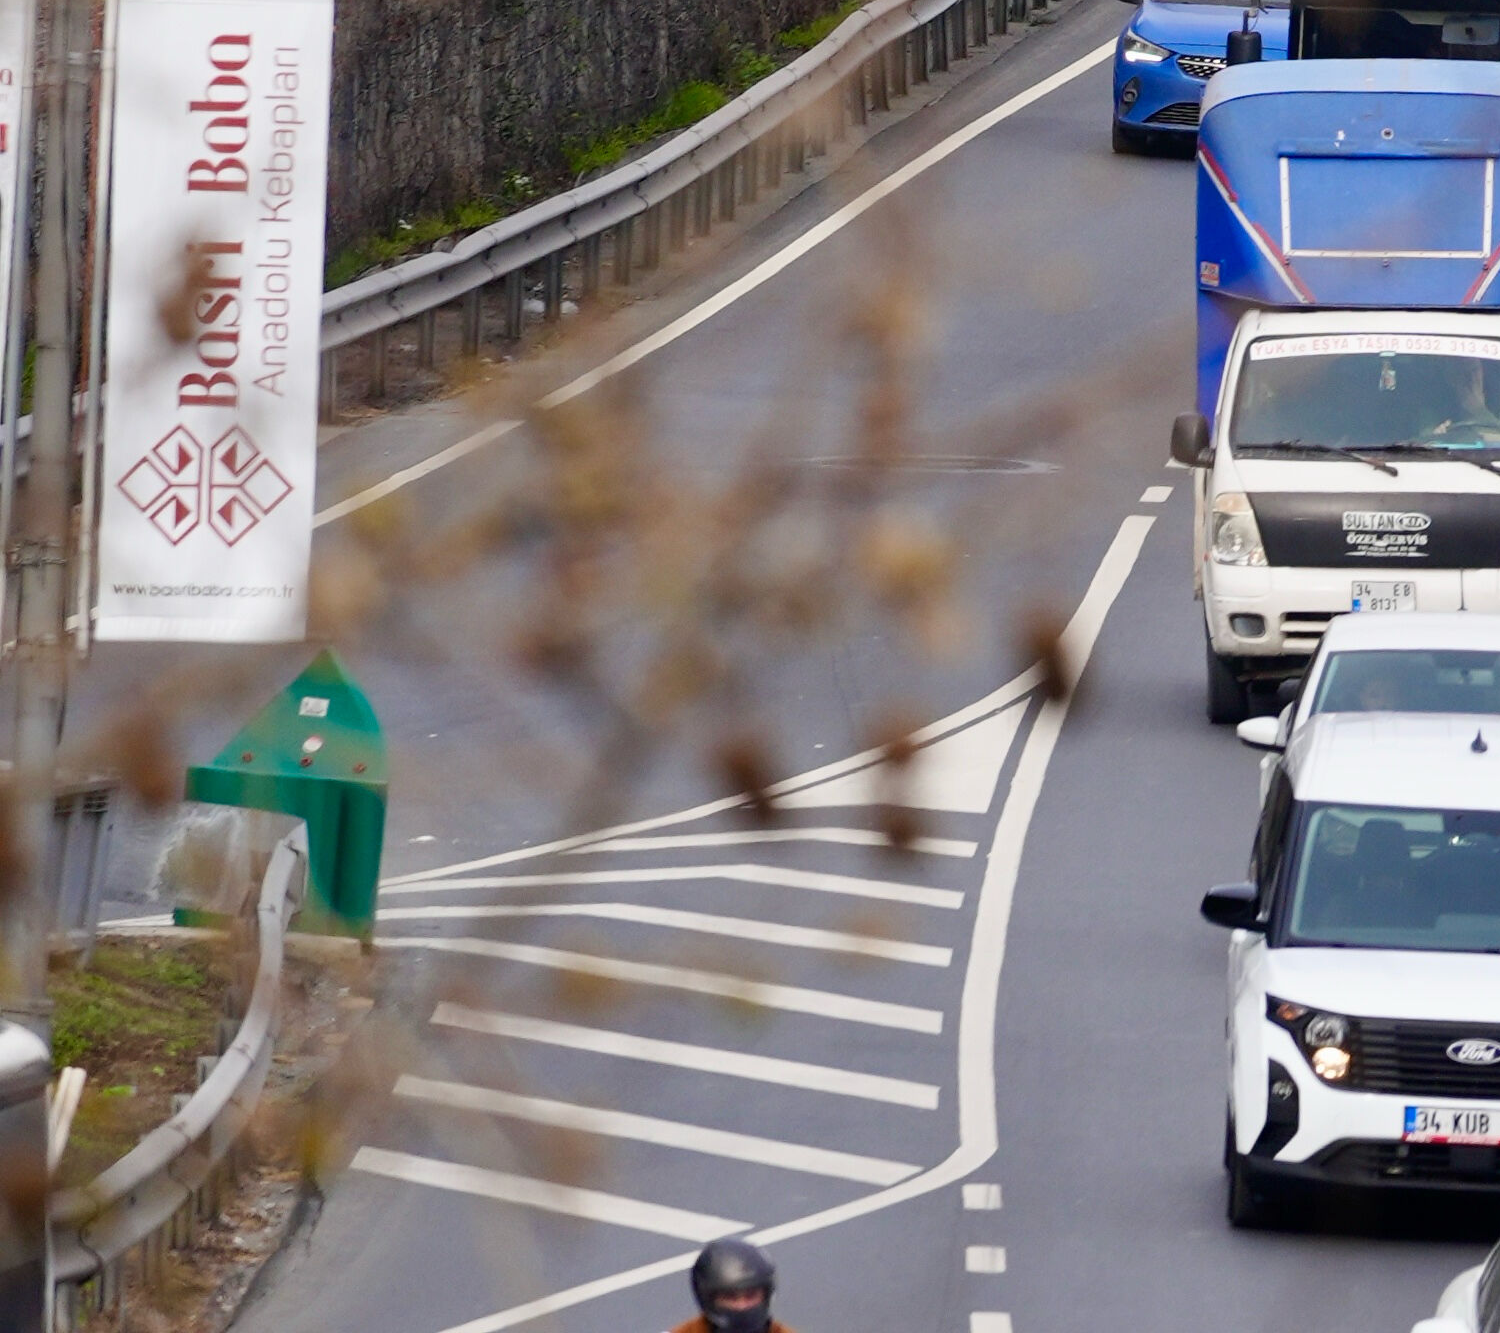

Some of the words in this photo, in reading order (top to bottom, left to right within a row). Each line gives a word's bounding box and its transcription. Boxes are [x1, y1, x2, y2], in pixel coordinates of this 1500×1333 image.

[187, 32, 252, 194] Baba
[258, 46, 306, 224] Kebapları
[178, 241, 244, 409] Basri
[253, 238, 292, 398] Anadolu
[1405, 340, 1441, 351] 0532
[1482, 343, 1499, 356] 43
[1344, 513, 1395, 528] SULTAN
[1356, 583, 1371, 596] 34
[1370, 597, 1398, 612] 8131
[1416, 1110, 1441, 1132] 34
[1452, 1112, 1490, 1135] KUB
